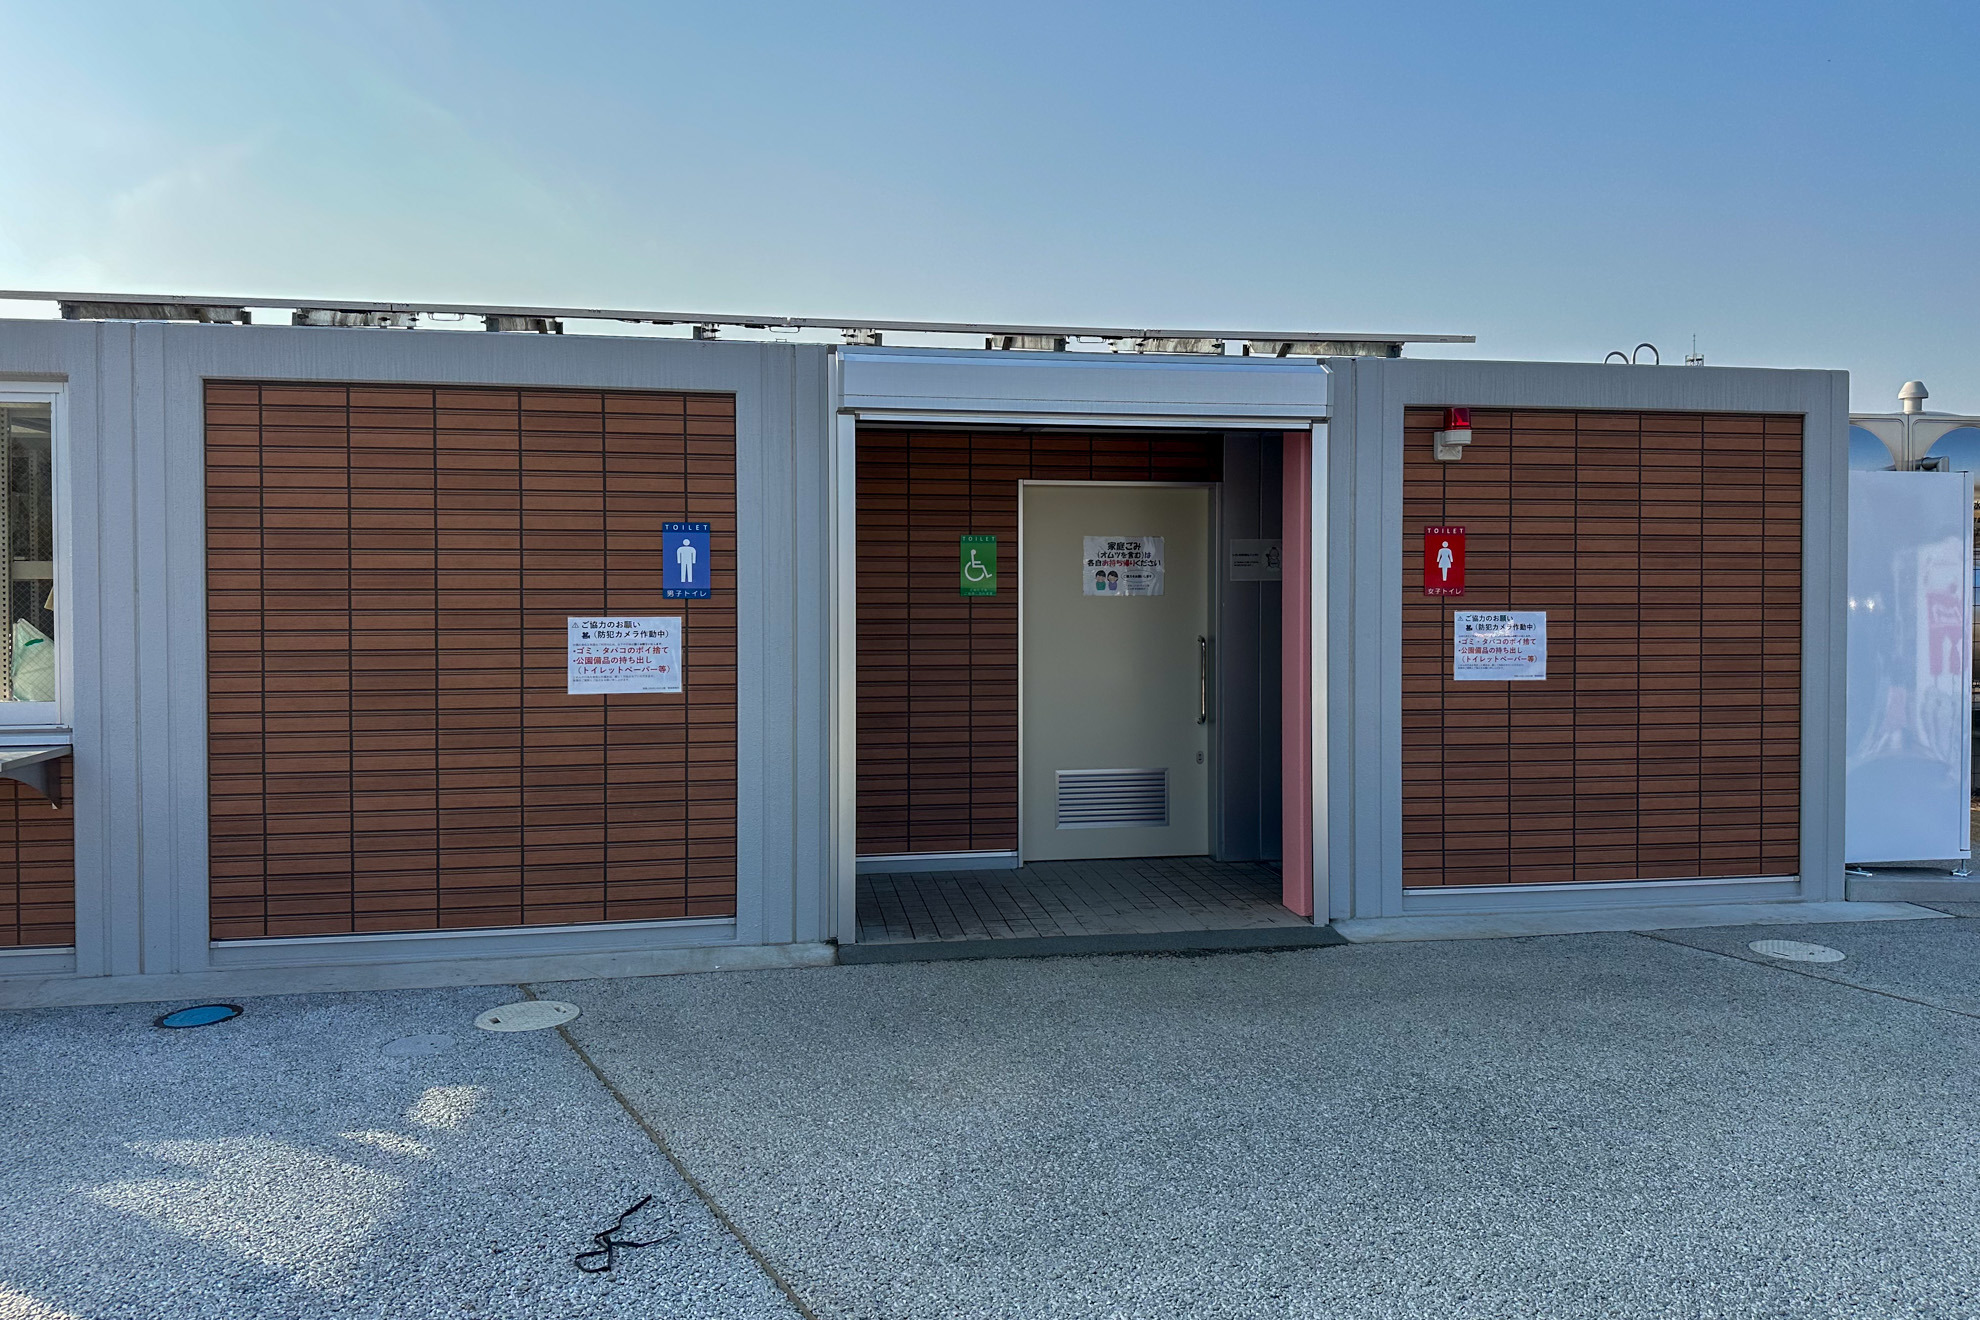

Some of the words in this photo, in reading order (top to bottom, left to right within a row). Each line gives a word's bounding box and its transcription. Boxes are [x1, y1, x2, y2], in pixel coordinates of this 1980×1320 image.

[1107, 541, 1141, 551] 家庭ごみ
[667, 590, 707, 598] 男子トイレ
[581, 621, 641, 629] ご協力のお願い
